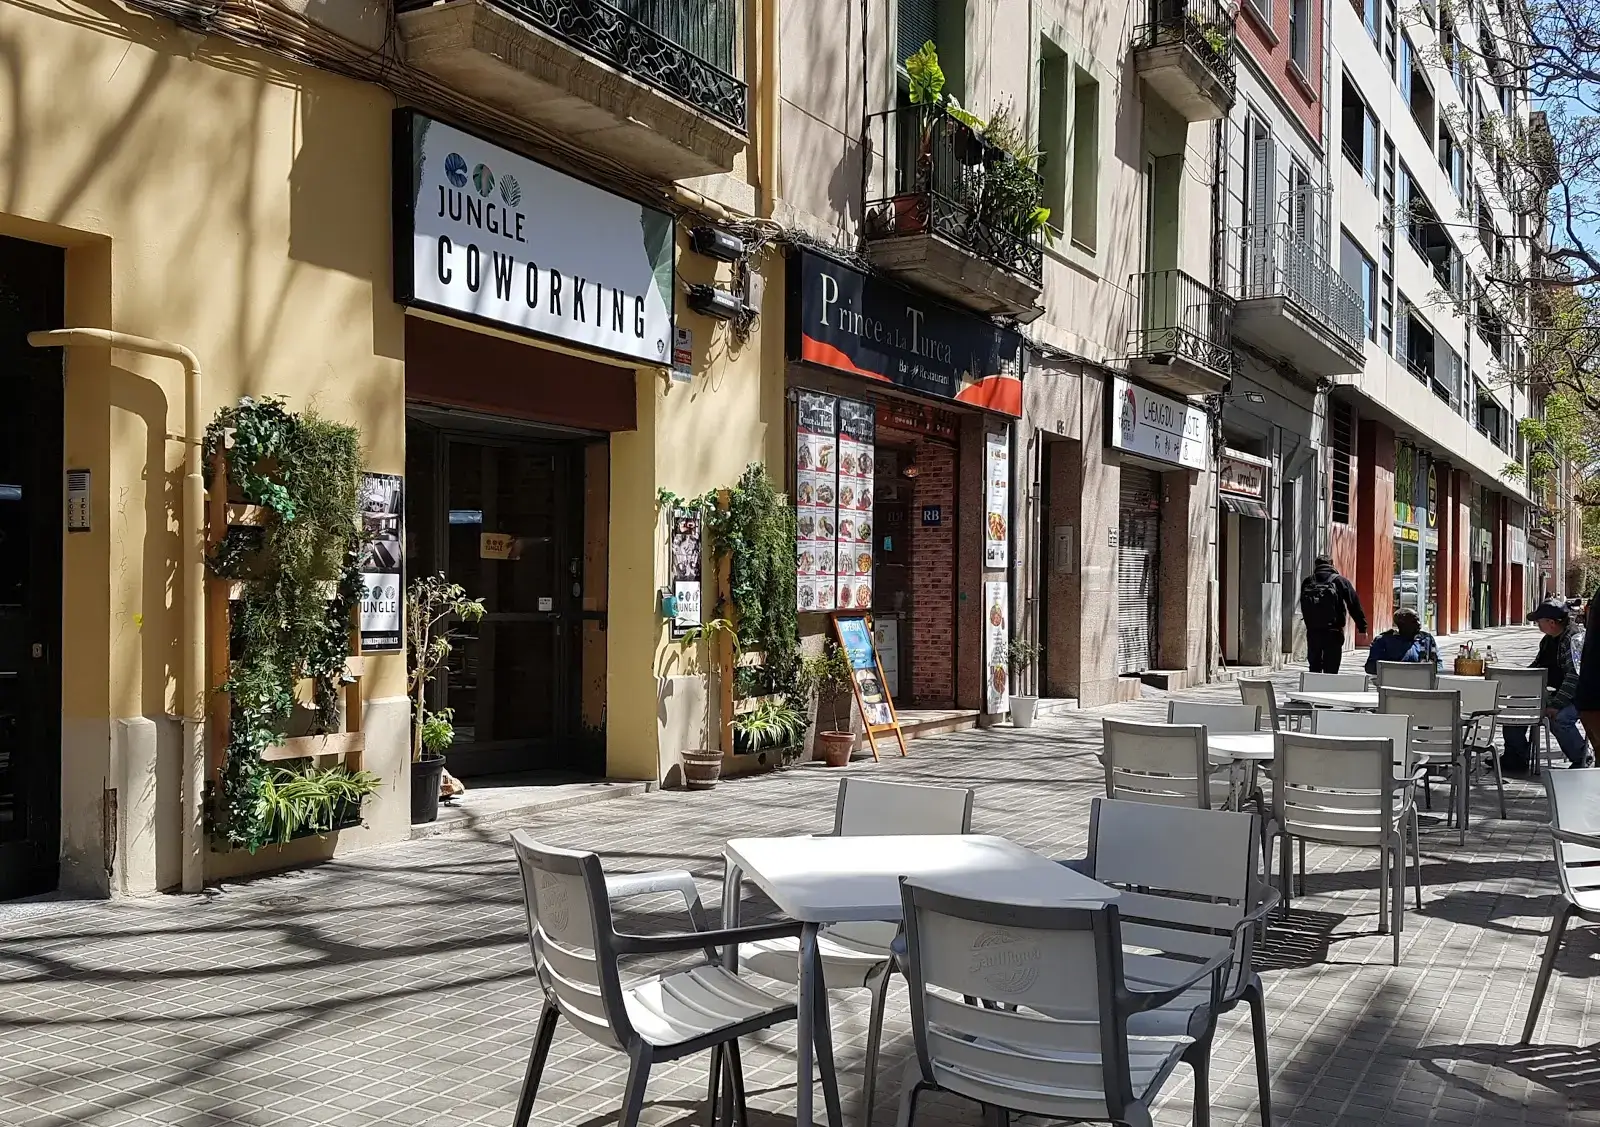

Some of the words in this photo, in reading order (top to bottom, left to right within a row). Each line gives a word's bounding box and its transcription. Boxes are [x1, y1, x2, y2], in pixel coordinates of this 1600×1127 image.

[437, 185, 527, 244] JUNGLE
[437, 234, 646, 339] COWORKING
[820, 272, 882, 342] Prince
[906, 306, 951, 365] Turca
[898, 358, 909, 374] Bar
[919, 364, 950, 385] Restaurant
[1143, 396, 1175, 429] CHENGDU
[1178, 411, 1200, 437] TASTE
[923, 510, 940, 522] RB
